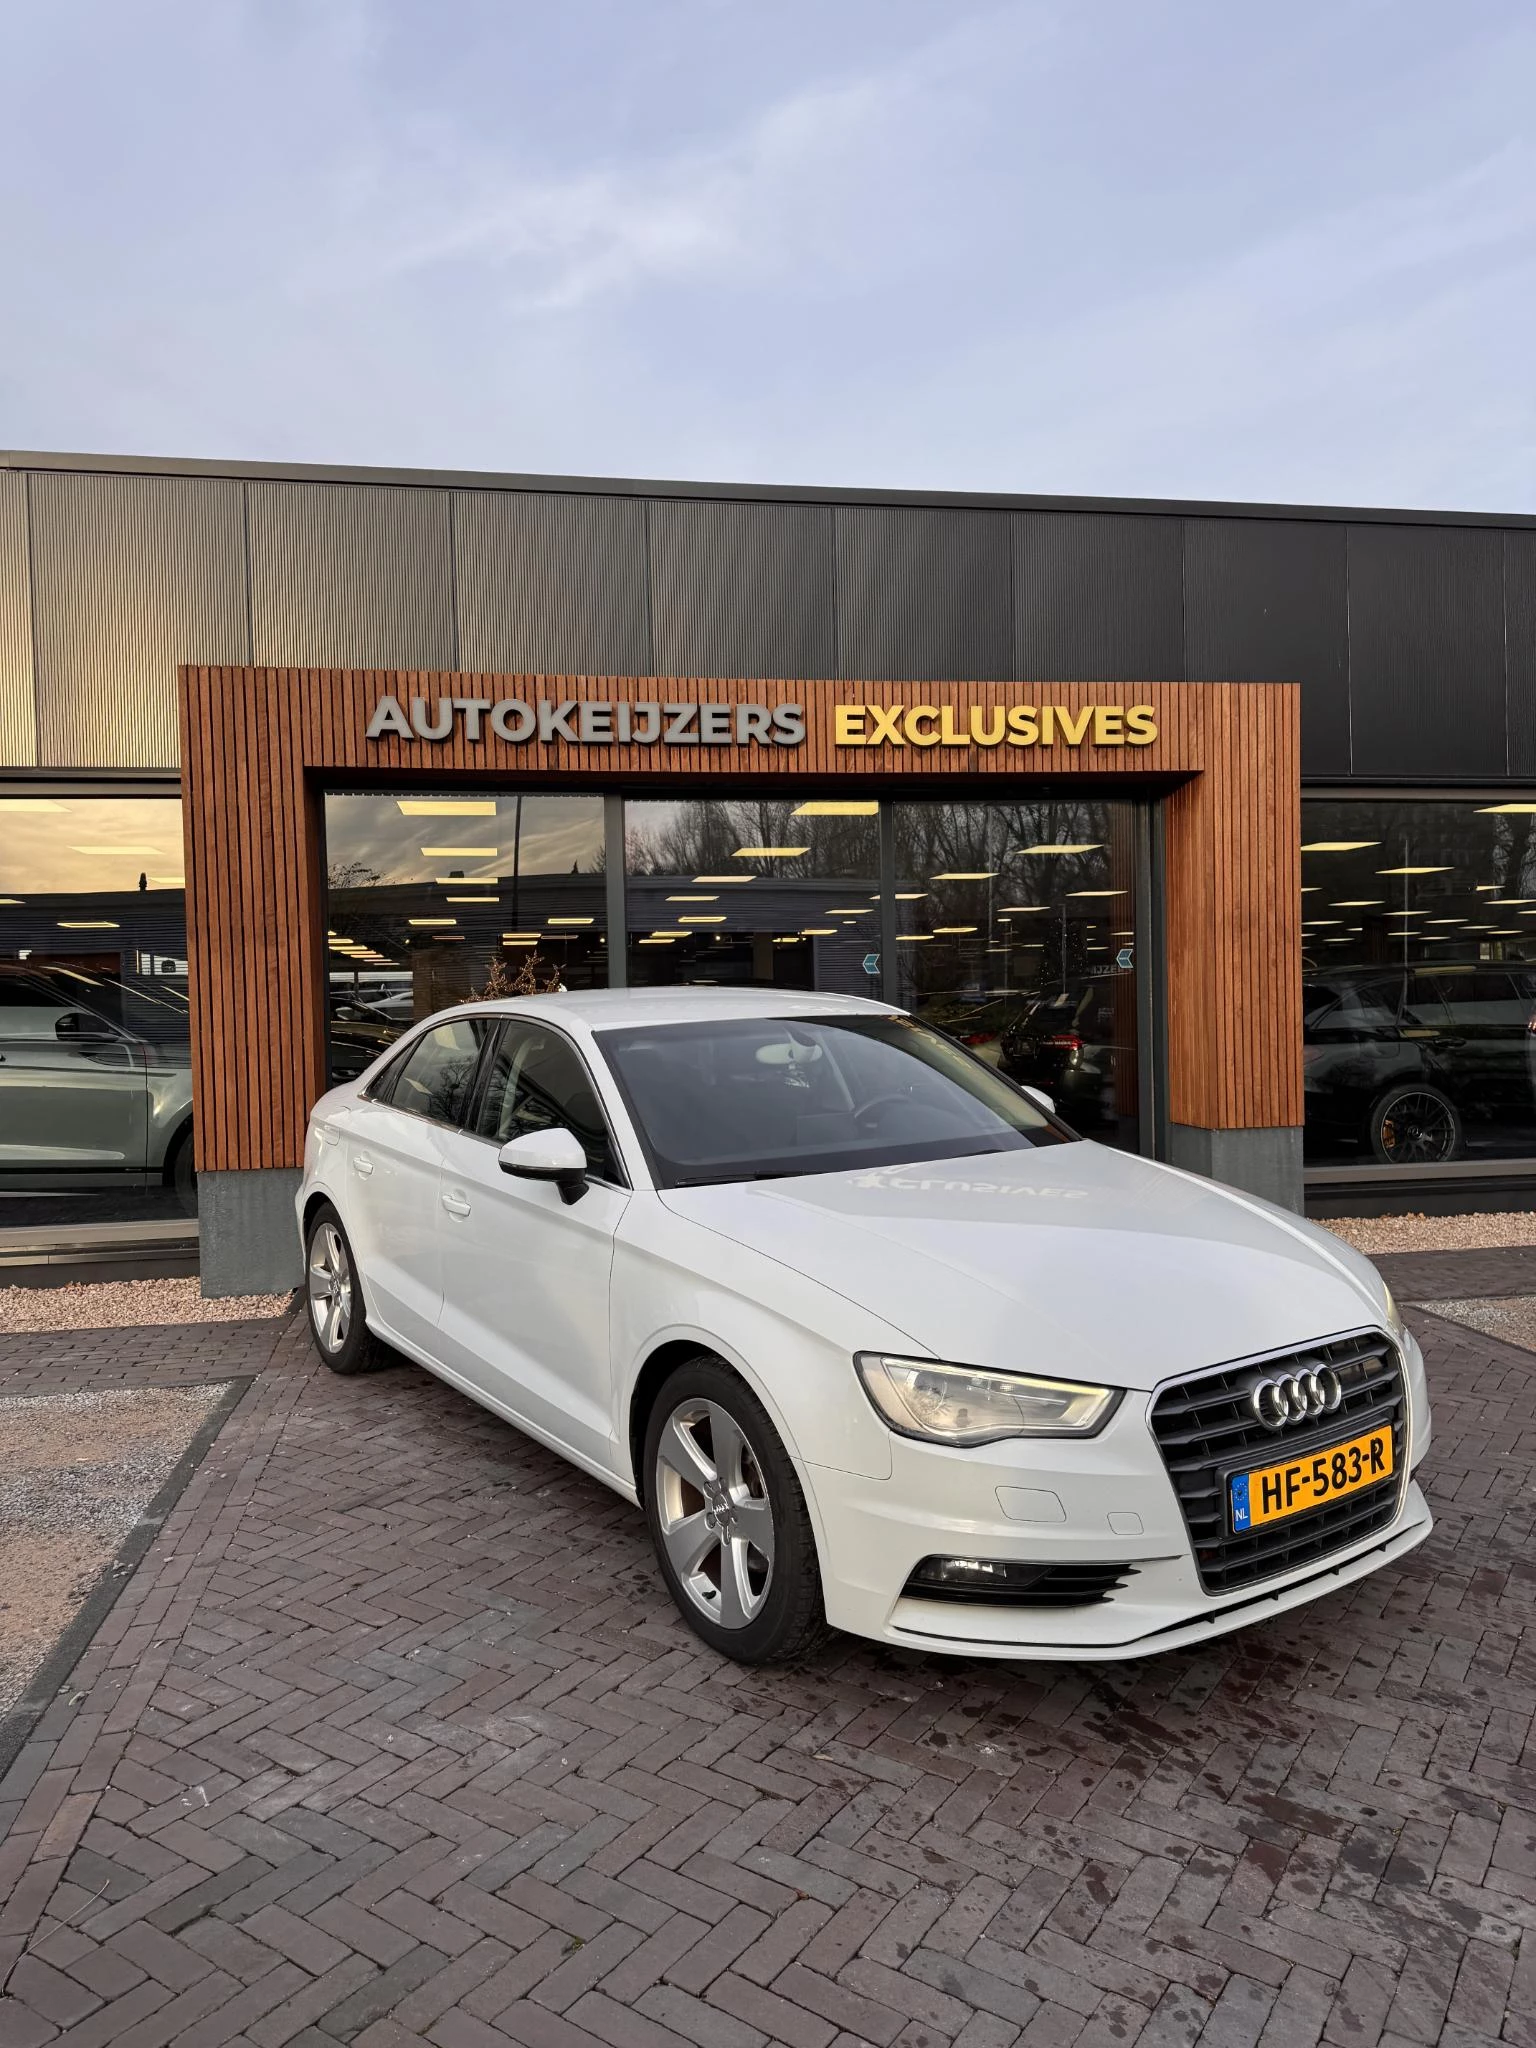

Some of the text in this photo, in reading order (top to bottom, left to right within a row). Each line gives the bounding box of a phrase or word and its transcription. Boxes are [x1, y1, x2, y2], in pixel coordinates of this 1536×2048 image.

[365, 695, 1158, 746] AUTOKEIJZERS EXCLUSIVES
[1262, 1438, 1385, 1514] HF-583-R
[1235, 1507, 1248, 1521] NL
